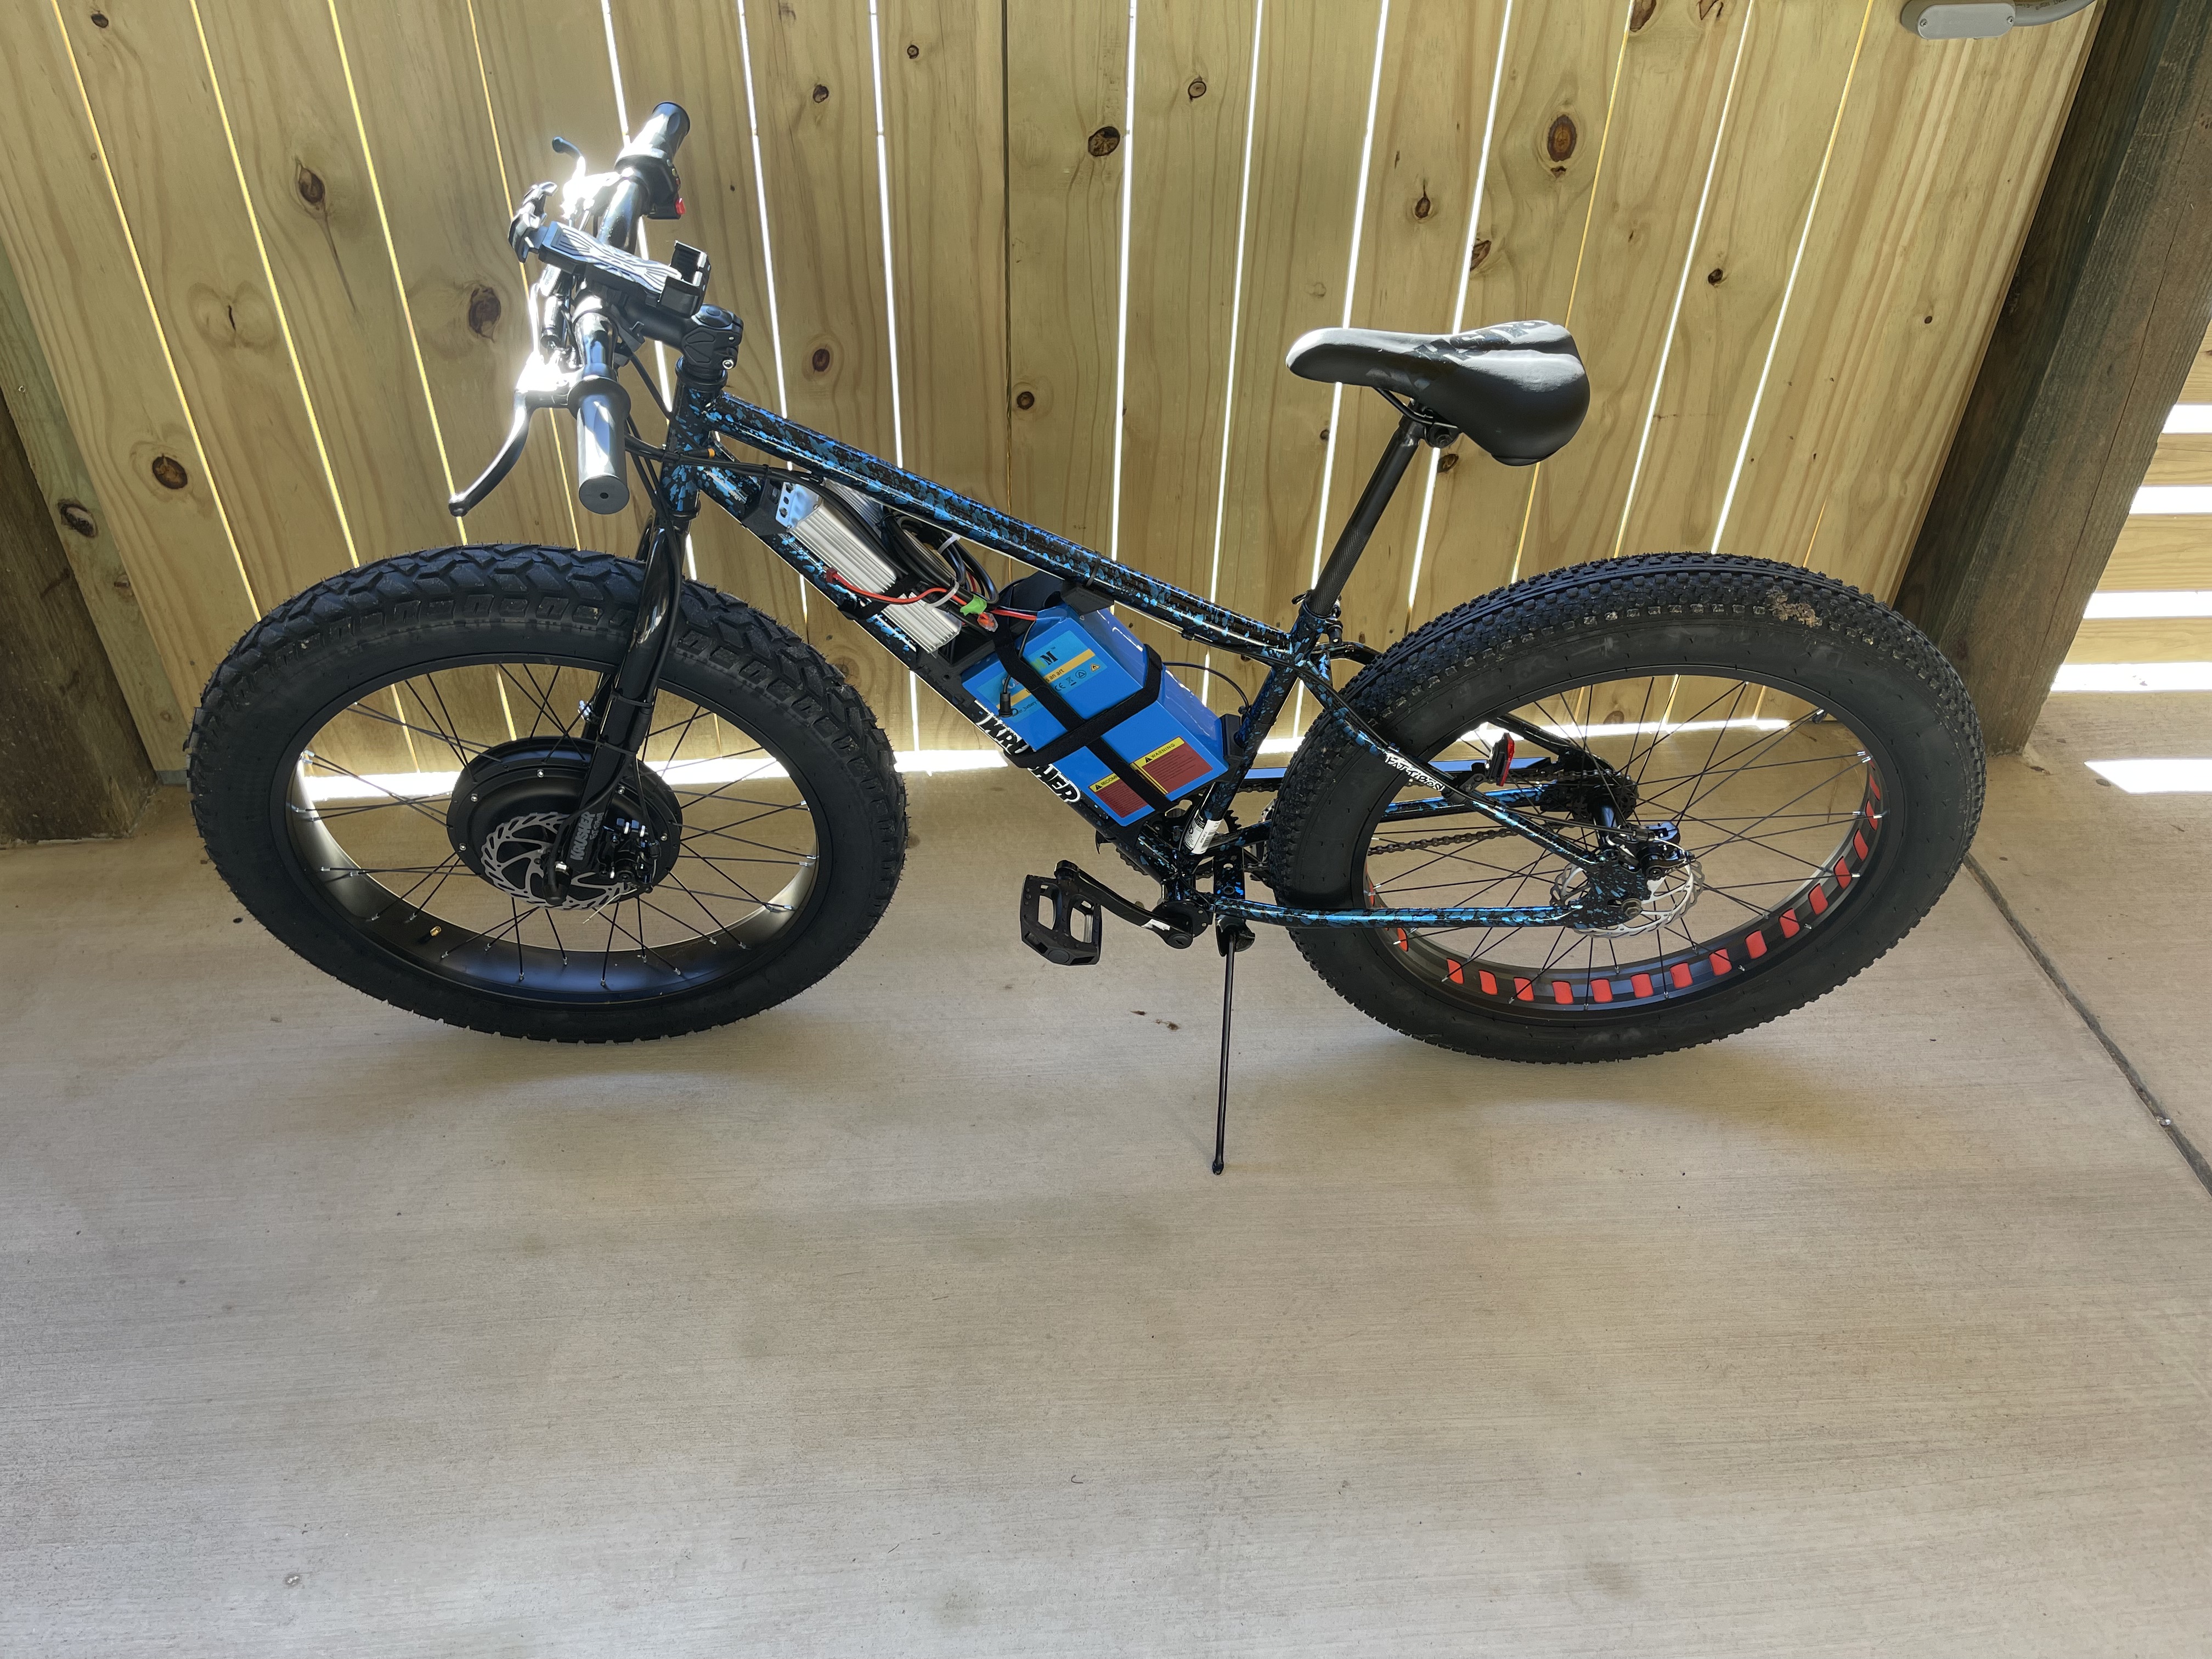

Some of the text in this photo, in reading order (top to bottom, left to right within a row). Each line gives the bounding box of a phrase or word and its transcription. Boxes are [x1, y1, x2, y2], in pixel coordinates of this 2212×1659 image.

[975, 712, 1081, 803] KRUHER
[1150, 743, 1175, 758] WARNING
[570, 811, 596, 861] KRUSHER
